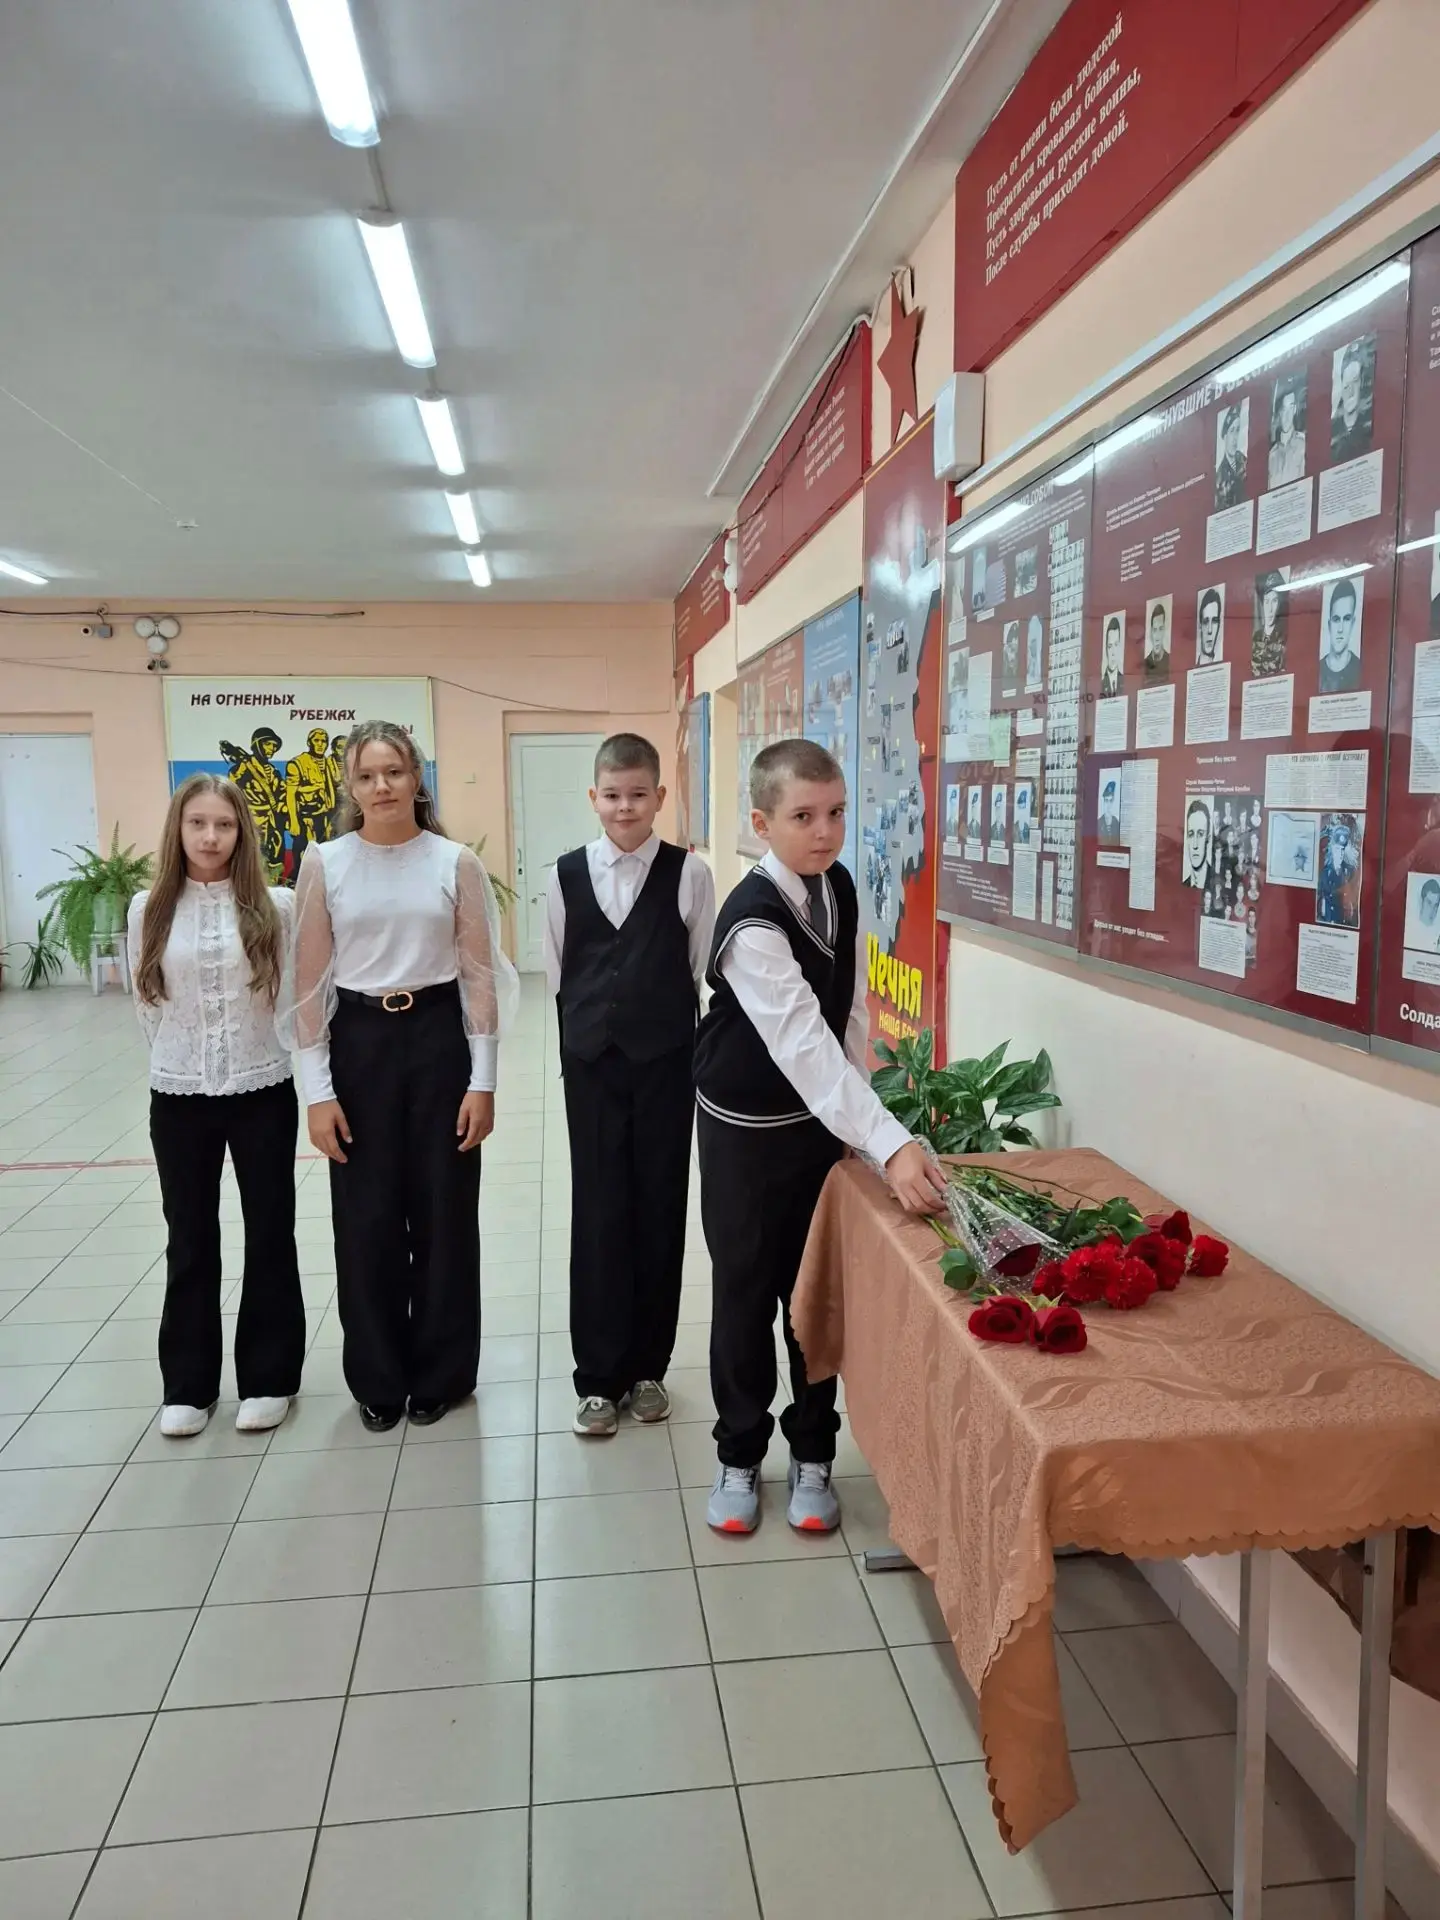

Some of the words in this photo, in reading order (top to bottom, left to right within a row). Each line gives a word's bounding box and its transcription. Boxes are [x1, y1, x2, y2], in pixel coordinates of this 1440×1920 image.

[985, 225, 1008, 260] Пусть
[1008, 165, 1055, 232] здоровыми
[1057, 116, 1097, 180] русские
[1099, 67, 1141, 125] воины,
[986, 172, 1008, 208] Пусть
[1009, 155, 1019, 176] от
[1020, 116, 1047, 162] имени
[1049, 83, 1074, 124] боли
[1075, 10, 1123, 92] людской
[986, 160, 1035, 234] Прекратится
[1036, 103, 1082, 169] кровавая
[1084, 57, 1121, 111] бойня,
[985, 251, 1008, 287] После
[1009, 211, 1041, 259] службы
[1042, 157, 1089, 221] приходят
[1090, 109, 1129, 170] домой.
[190, 693, 211, 706] НА
[216, 693, 295, 706] ОГНЕННЫХ
[289, 709, 356, 721] РУБЕЖАХ
